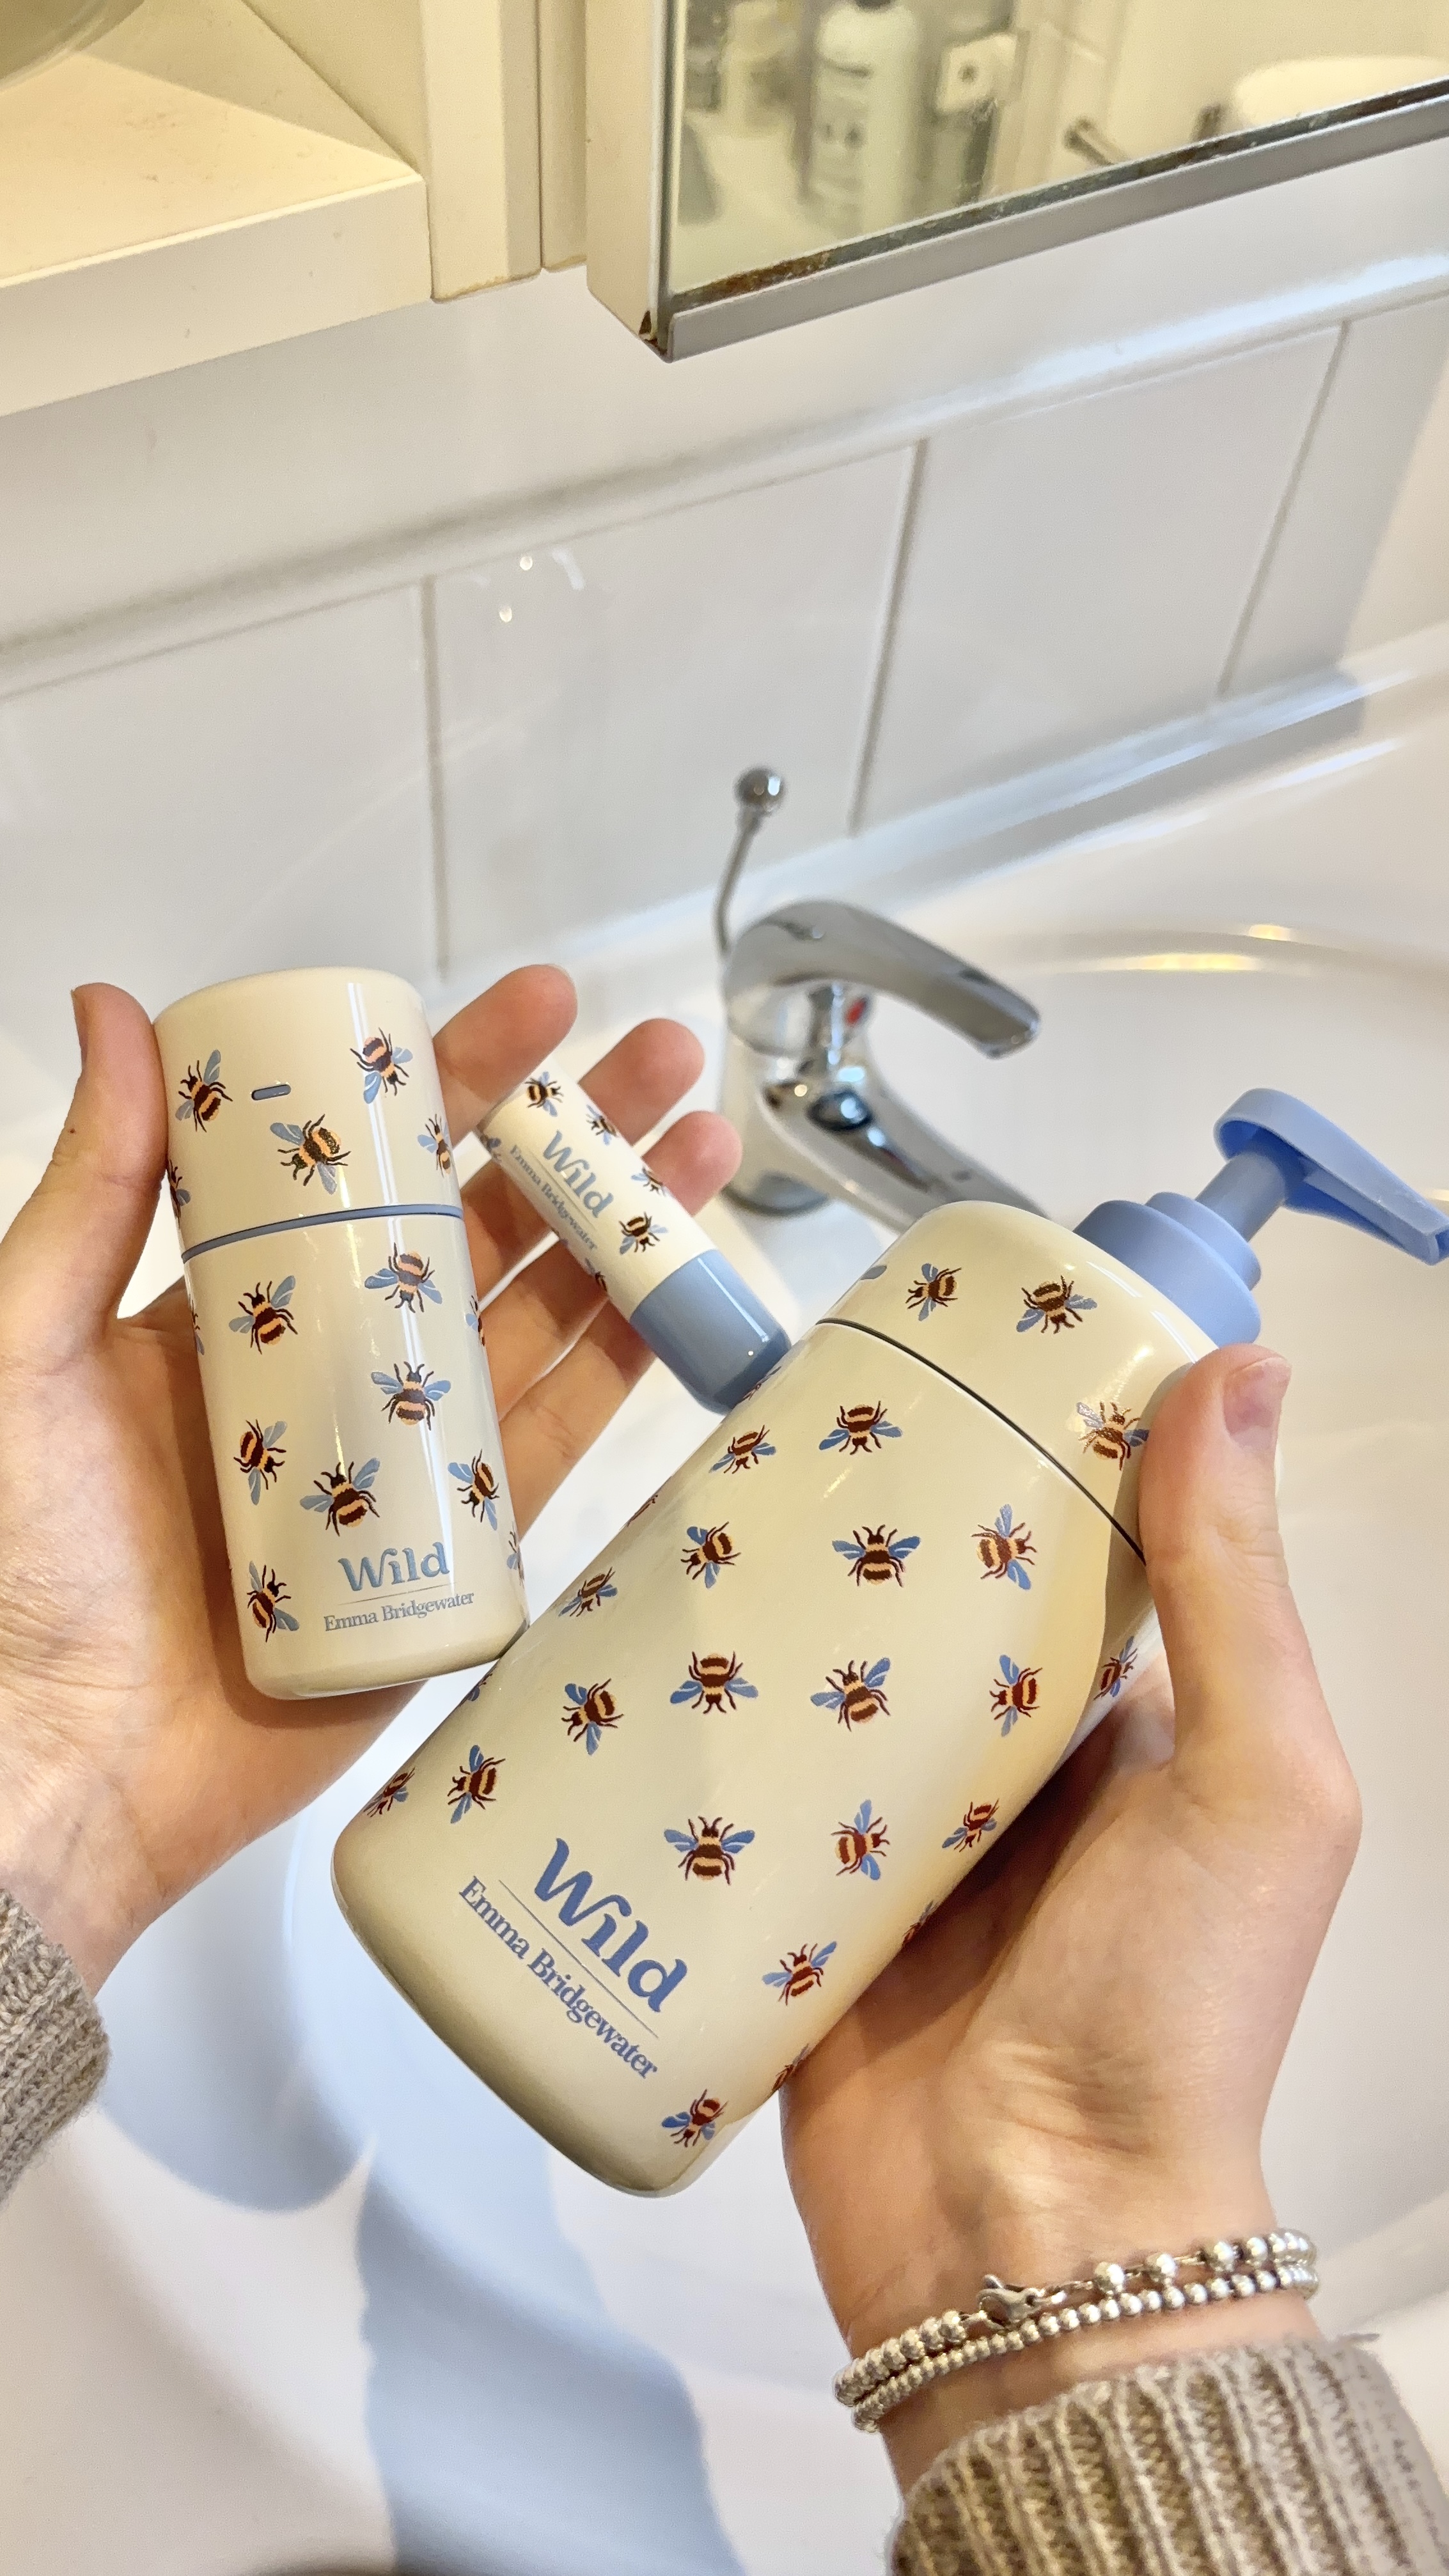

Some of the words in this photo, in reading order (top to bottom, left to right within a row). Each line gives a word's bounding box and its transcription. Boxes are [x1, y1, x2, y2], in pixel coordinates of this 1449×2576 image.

[510, 1144, 542, 1186] Emma
[541, 1182, 598, 1251] Bridgewater
[542, 1130, 614, 1218] Wild
[324, 1611, 379, 1632] Emma
[381, 1592, 474, 1621] Bridgewater
[338, 1542, 450, 1591] Wild
[534, 1838, 688, 2013] Wild
[458, 1875, 530, 1960] Emma
[527, 1948, 658, 2079] Bridgewater
